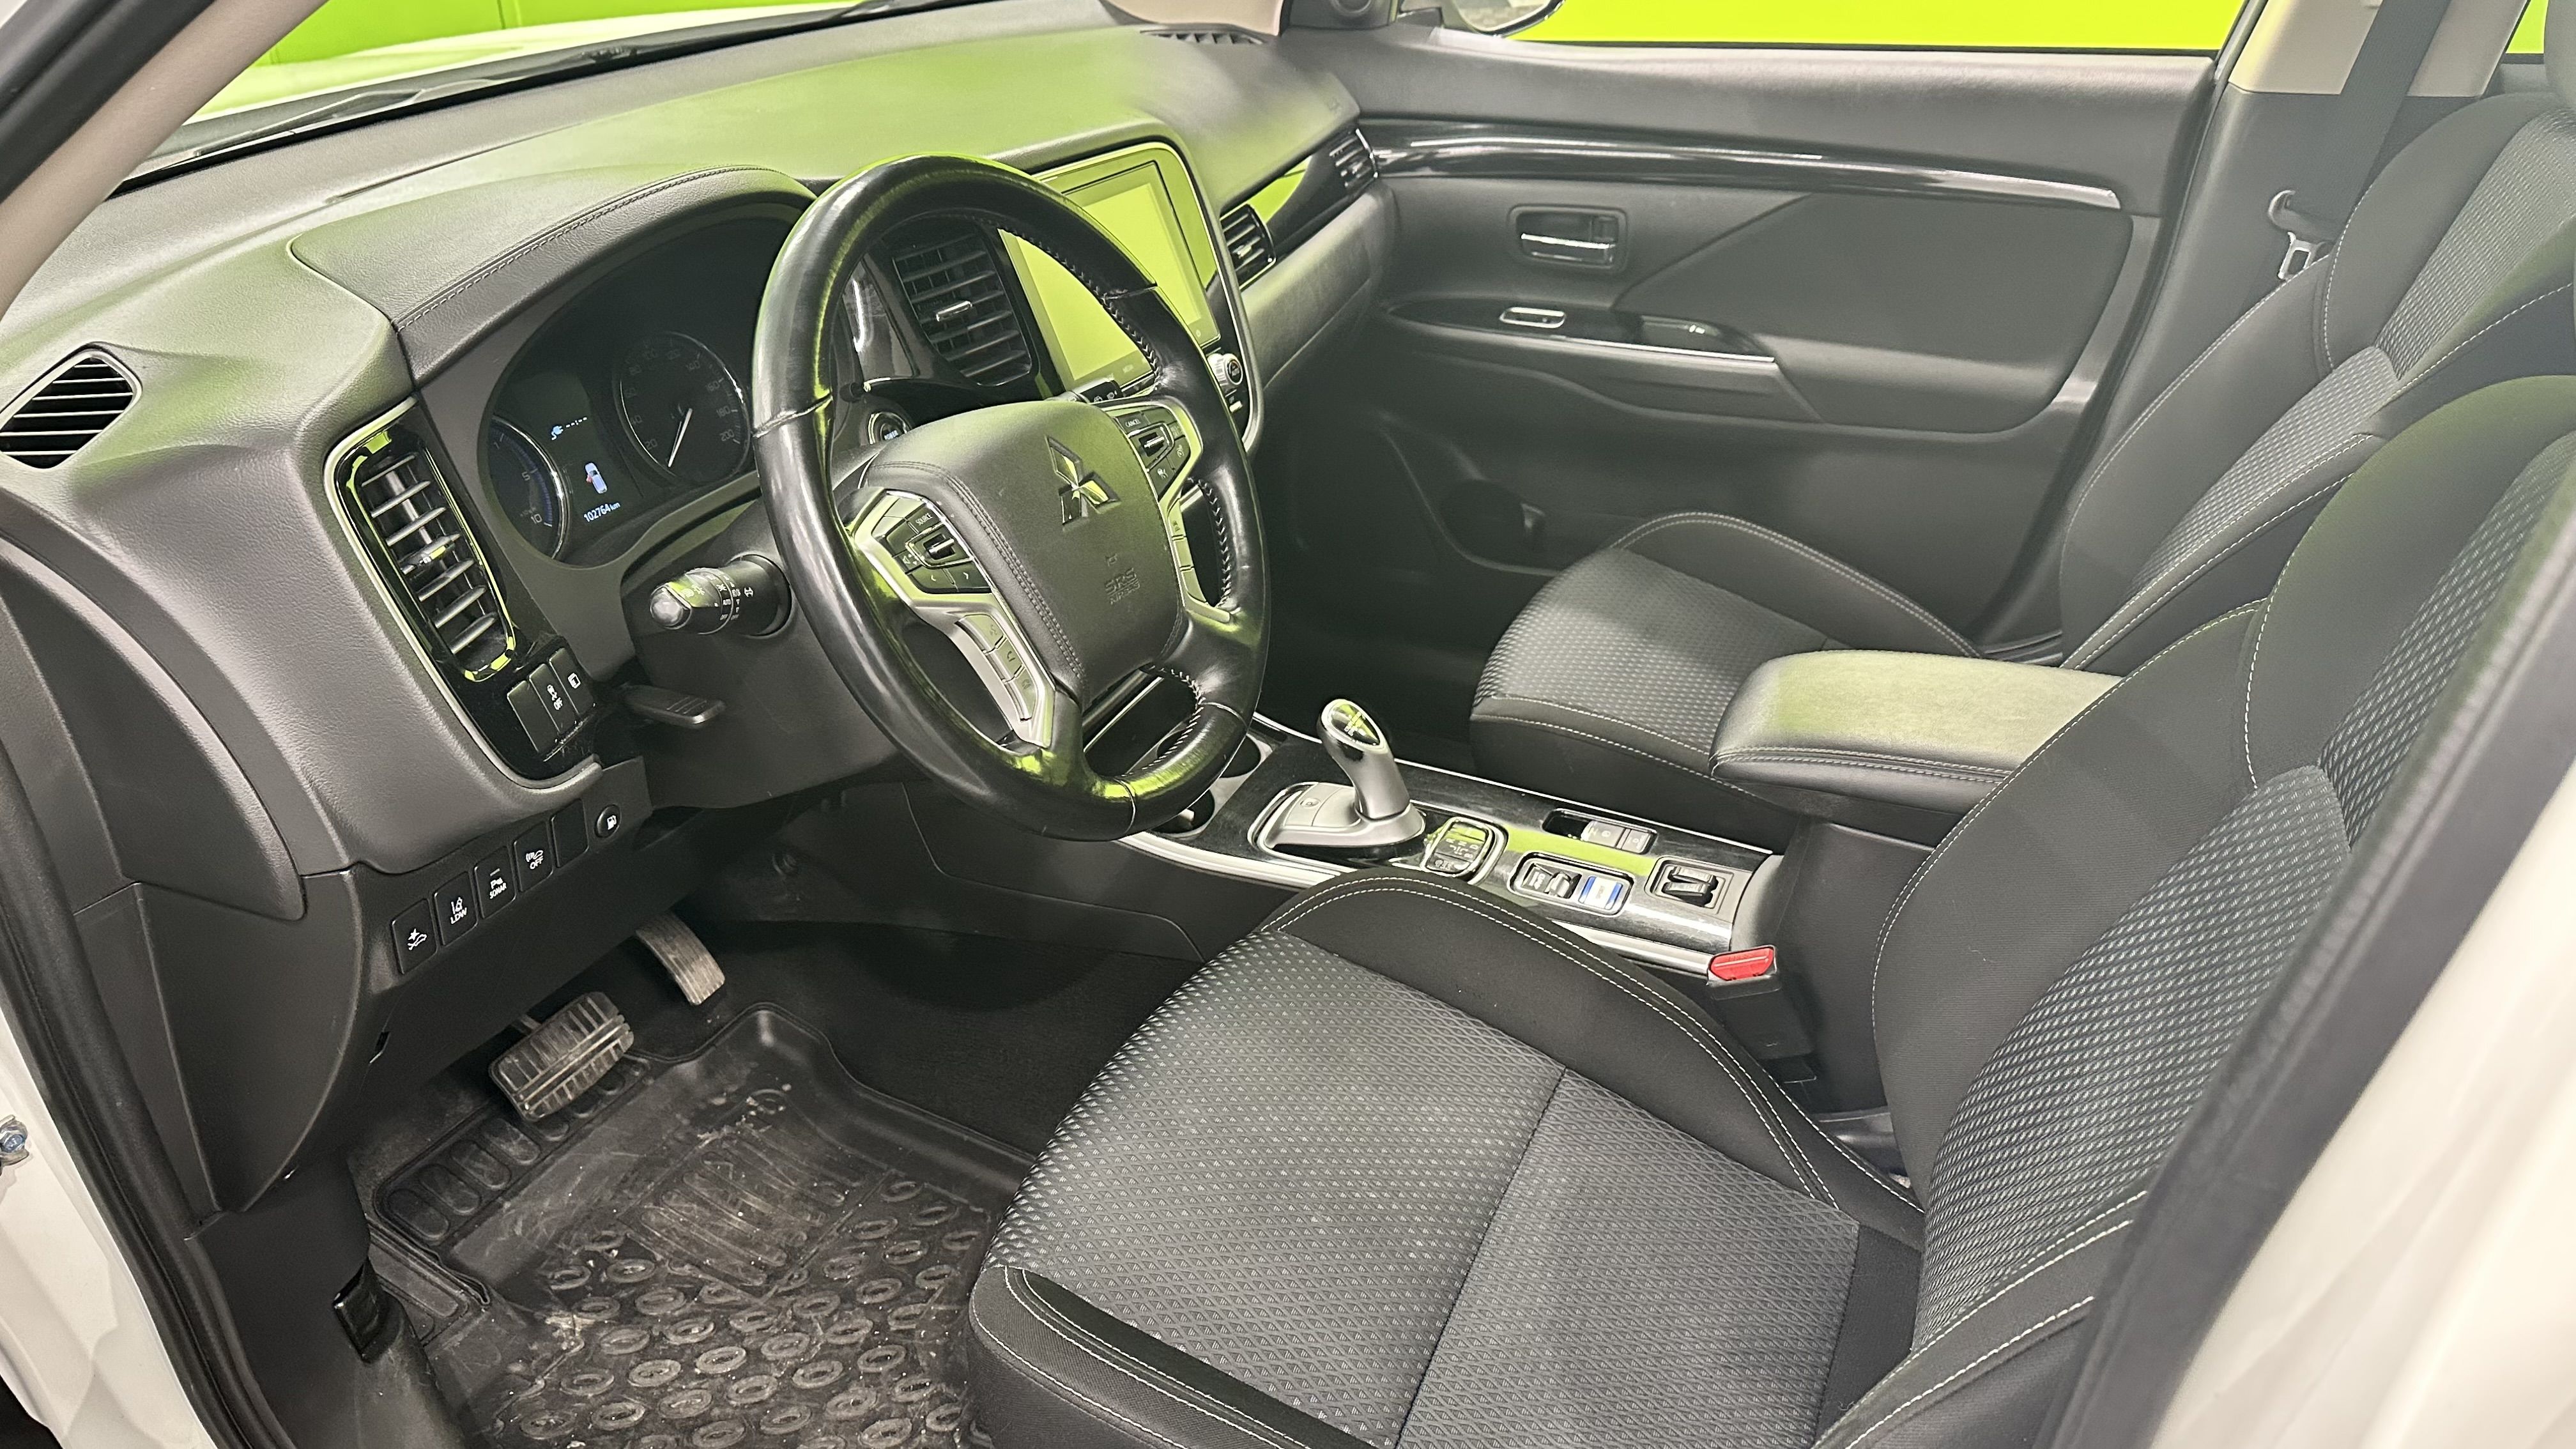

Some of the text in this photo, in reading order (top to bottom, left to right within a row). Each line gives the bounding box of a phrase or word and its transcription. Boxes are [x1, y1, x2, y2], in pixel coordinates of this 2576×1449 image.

[1125, 418, 1142, 427] CANCEL
[719, 429, 735, 441] 200
[644, 438, 657, 450] 20
[521, 471, 531, 481] 5
[583, 502, 621, 522] 102764 km
[530, 513, 543, 525] 10
[915, 512, 933, 525] SOURCE
[530, 855, 544, 870] OFF
[489, 882, 507, 900] SONAR
[450, 907, 468, 924] LDW
